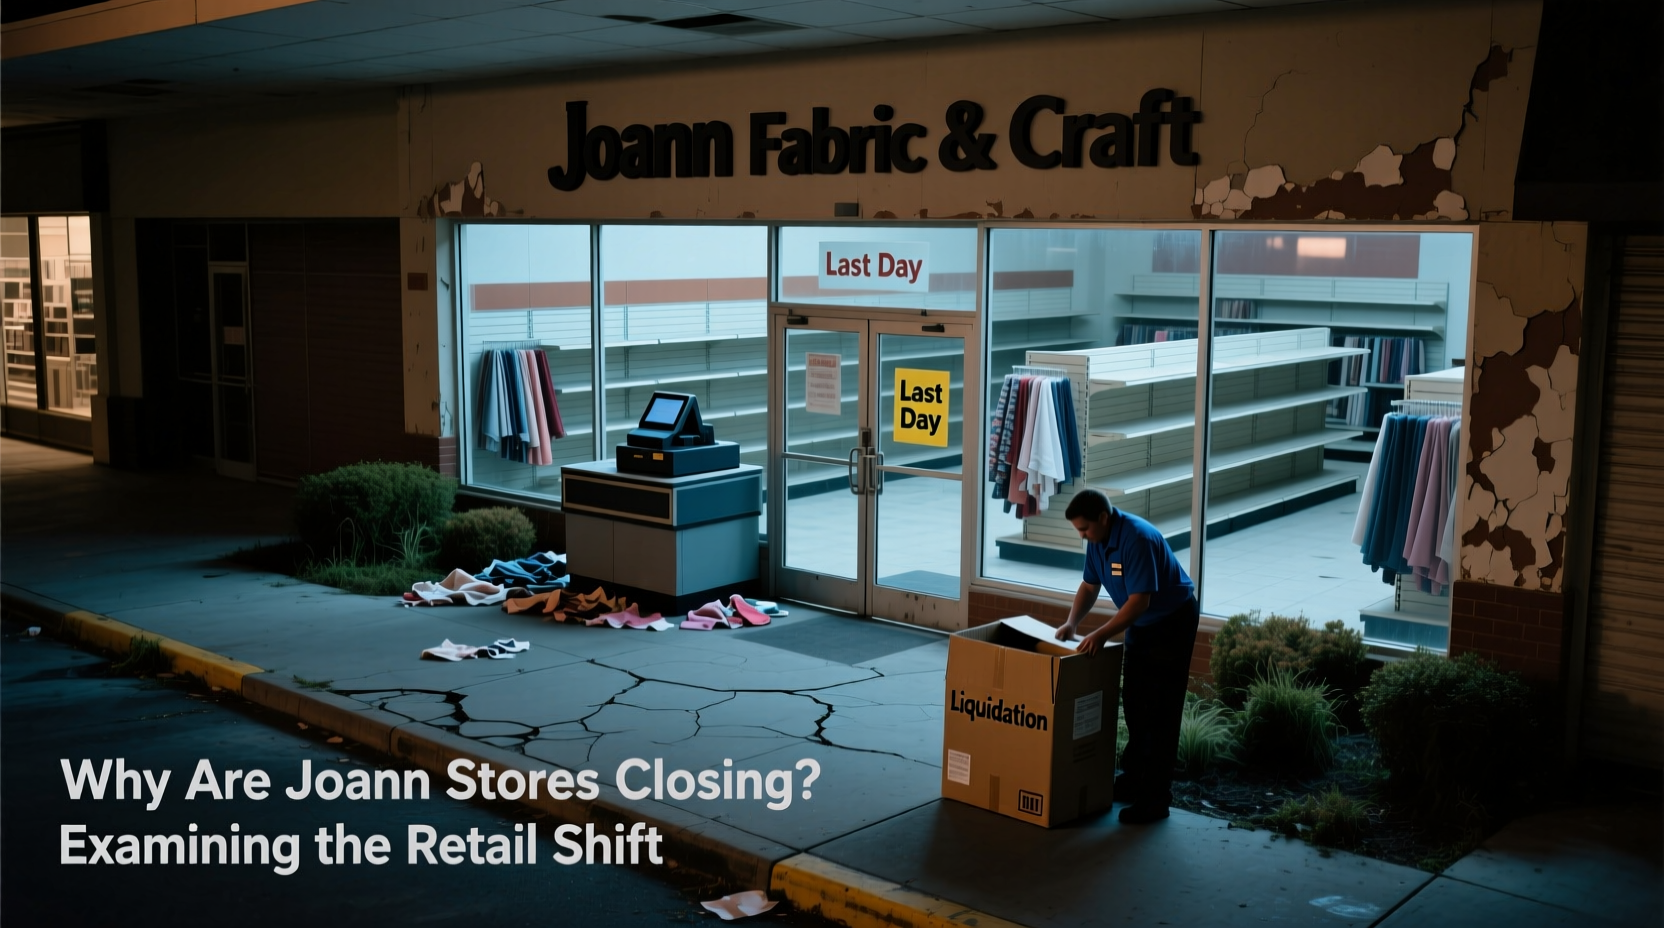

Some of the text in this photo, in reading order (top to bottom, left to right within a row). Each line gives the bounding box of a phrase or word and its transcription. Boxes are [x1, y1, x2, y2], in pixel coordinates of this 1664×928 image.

[548, 88, 1202, 192] Joann Fabric & Craft
[826, 251, 923, 284] Last Day
[900, 379, 943, 404] Last
[900, 407, 942, 436] Day
[950, 689, 1048, 731] Liquidation
